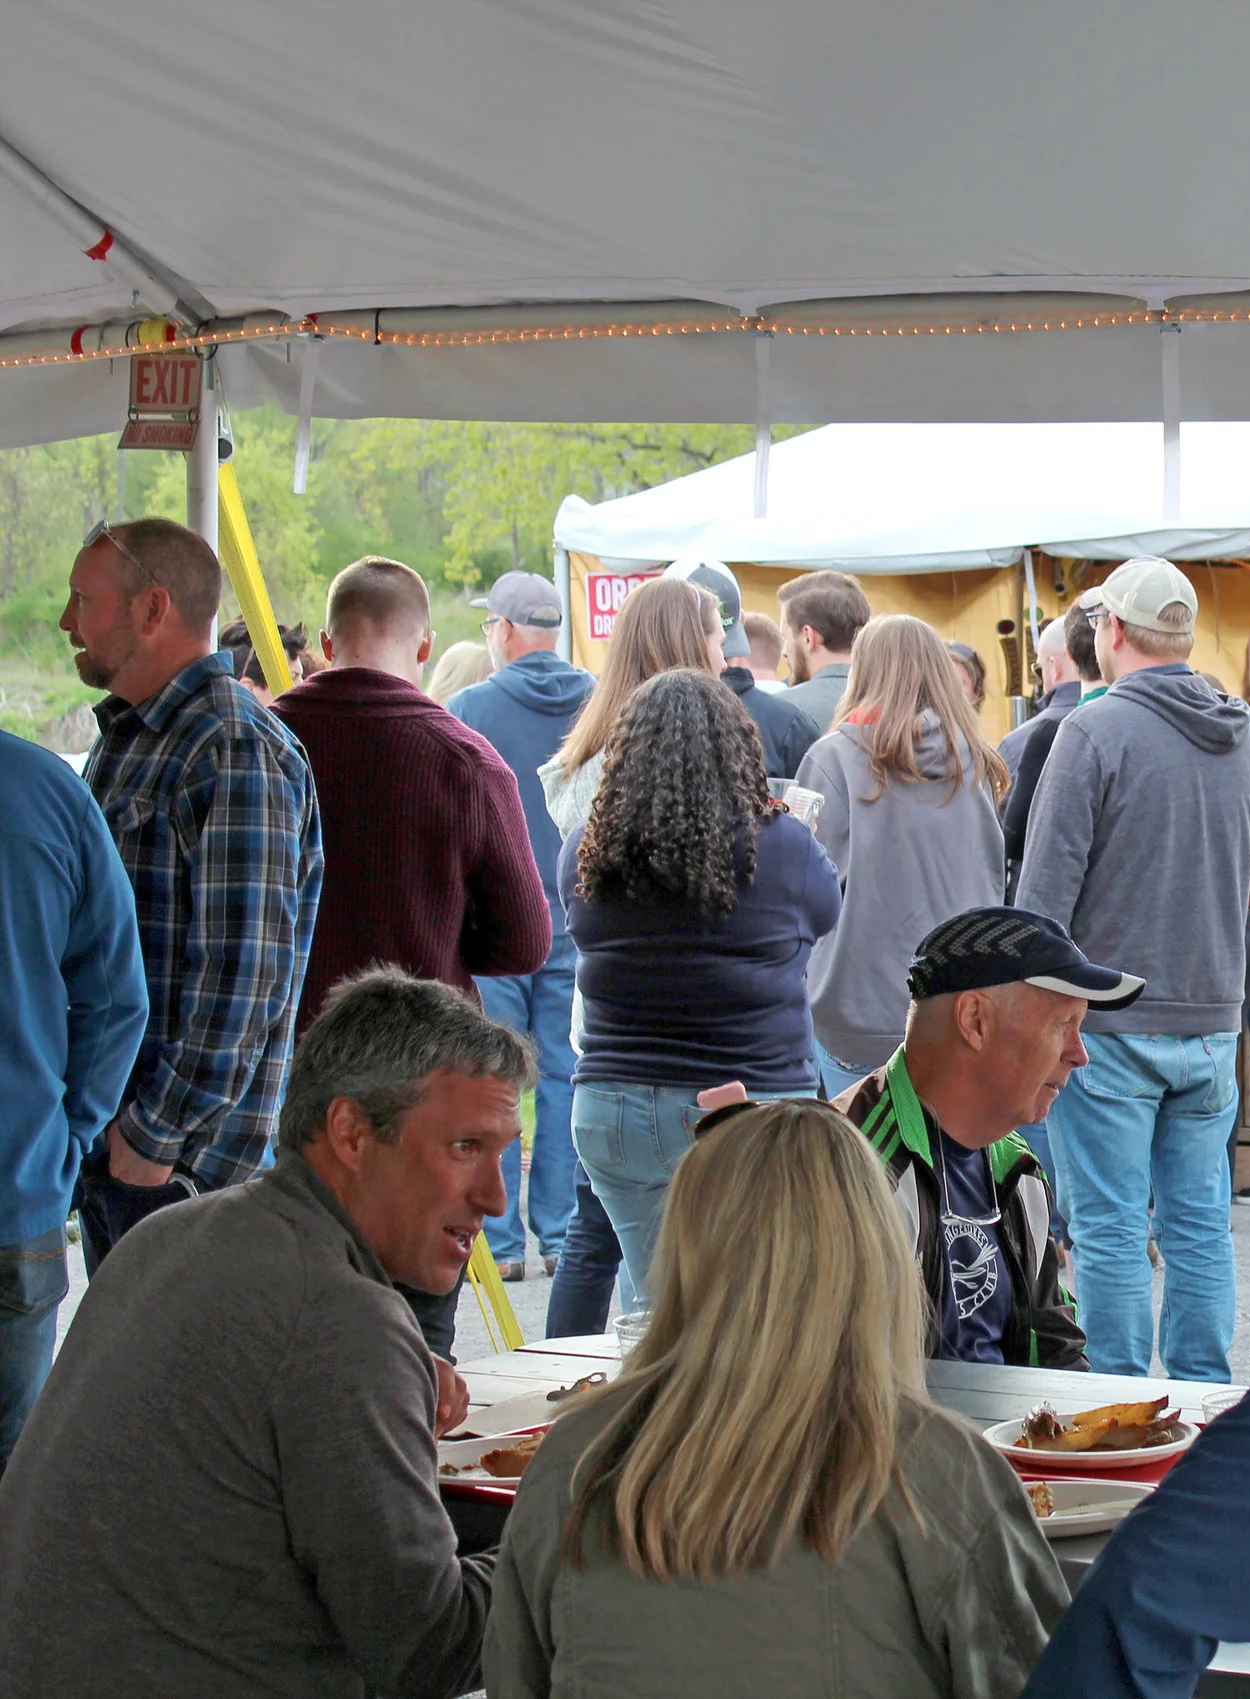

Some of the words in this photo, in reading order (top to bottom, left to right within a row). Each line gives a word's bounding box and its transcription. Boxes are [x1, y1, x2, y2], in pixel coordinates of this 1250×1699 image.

[136, 360, 196, 404] EXIT
[125, 424, 142, 443] NO
[143, 425, 194, 445] SMOKING
[973, 1272, 997, 1307] CLUB
